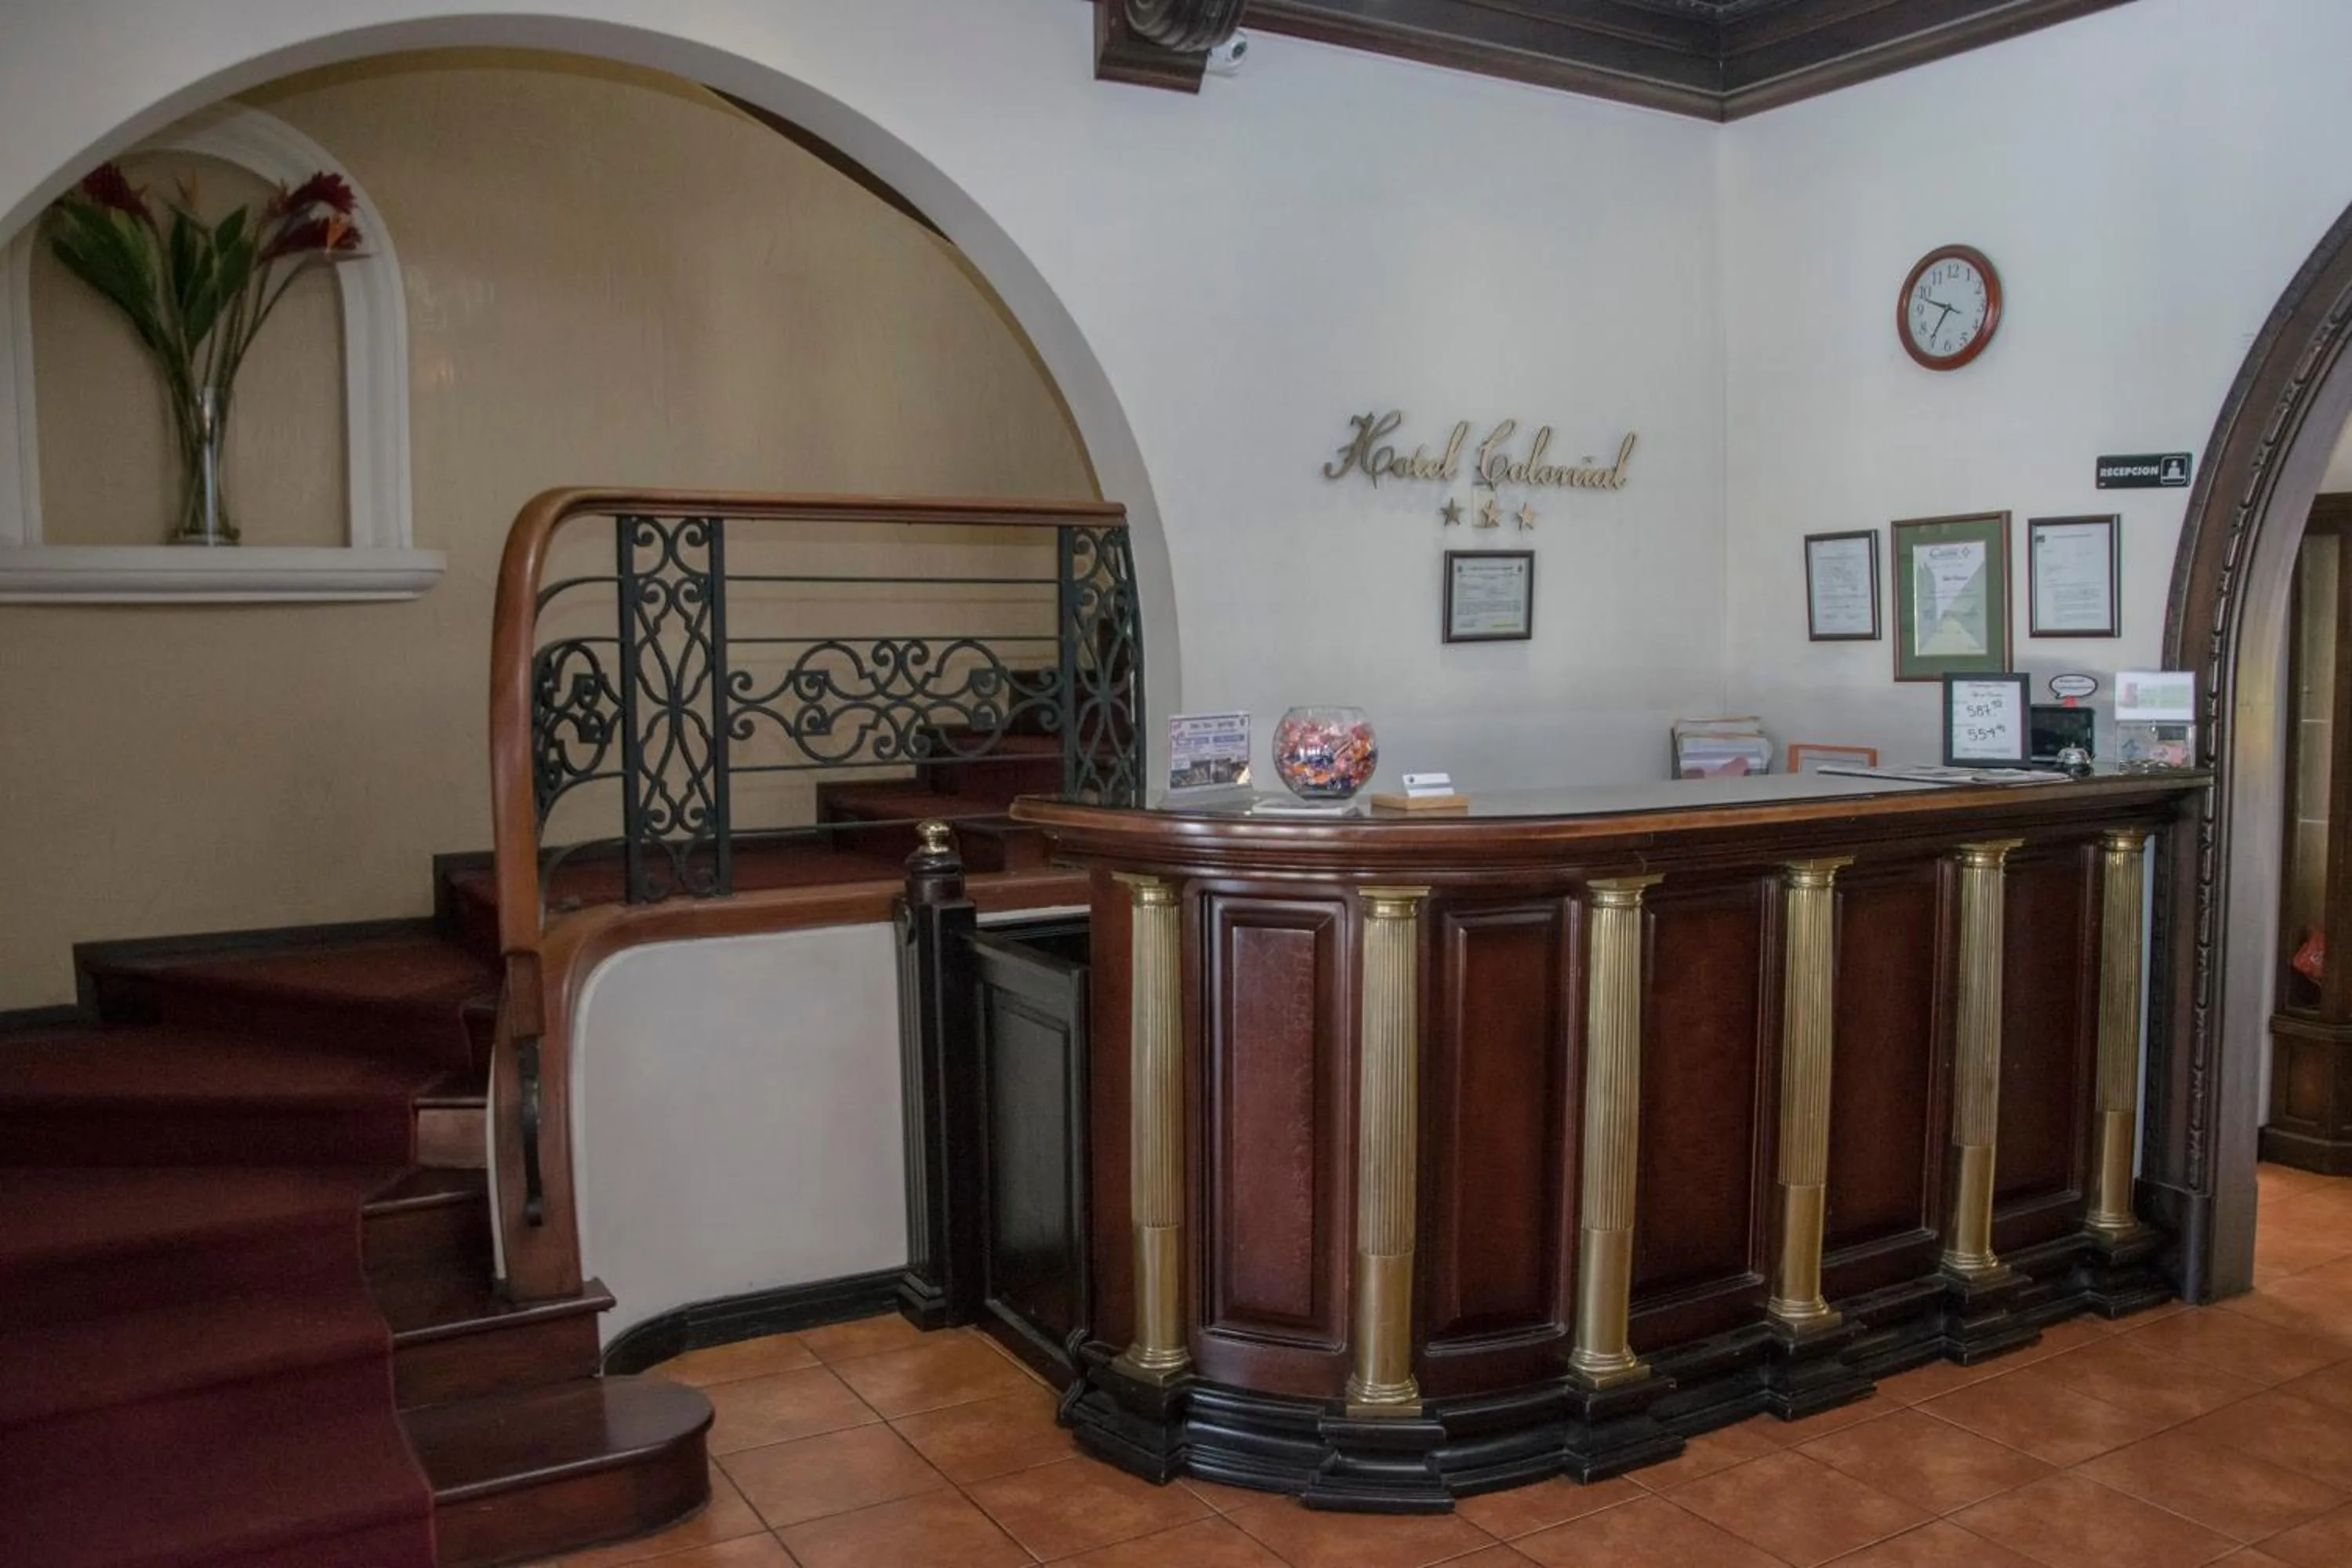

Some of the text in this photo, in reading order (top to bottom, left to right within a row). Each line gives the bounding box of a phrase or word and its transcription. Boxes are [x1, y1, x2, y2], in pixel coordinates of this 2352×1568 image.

[1947, 263, 1959, 278] 12
[1966, 268, 1971, 281] 1
[1933, 270, 1943, 285] 11
[1974, 281, 1982, 294] 2
[1917, 303, 1924, 316] 9
[1973, 318, 1980, 330] 4
[1944, 340, 1951, 352] 6
[1959, 332, 1969, 347] 5
[1323, 410, 1637, 491] Hotel Colonial
[2100, 465, 2160, 477] RECEPCION
